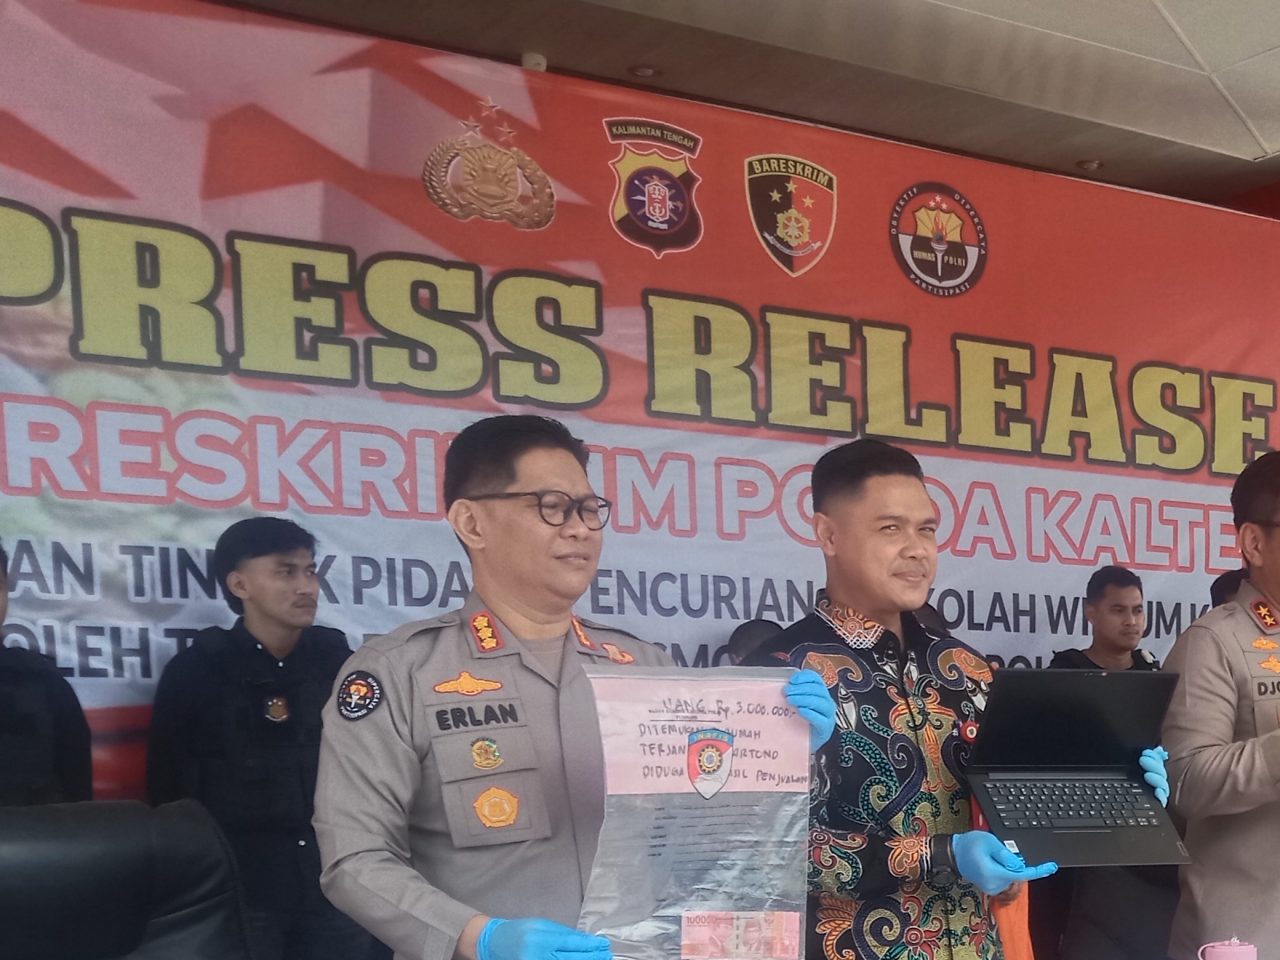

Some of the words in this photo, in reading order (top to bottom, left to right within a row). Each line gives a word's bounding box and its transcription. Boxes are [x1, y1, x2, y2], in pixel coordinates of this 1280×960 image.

[611, 125, 662, 138] KALIMANTAN
[662, 130, 695, 149] TENGAH
[752, 160, 830, 187] BARESKRIM
[943, 255, 966, 267] POLRI
[909, 273, 971, 296] PARTISIPASI
[643, 289, 1278, 477] RELEASE
[591, 568, 815, 624] ENCURIAN
[435, 703, 519, 731] ERLAN
